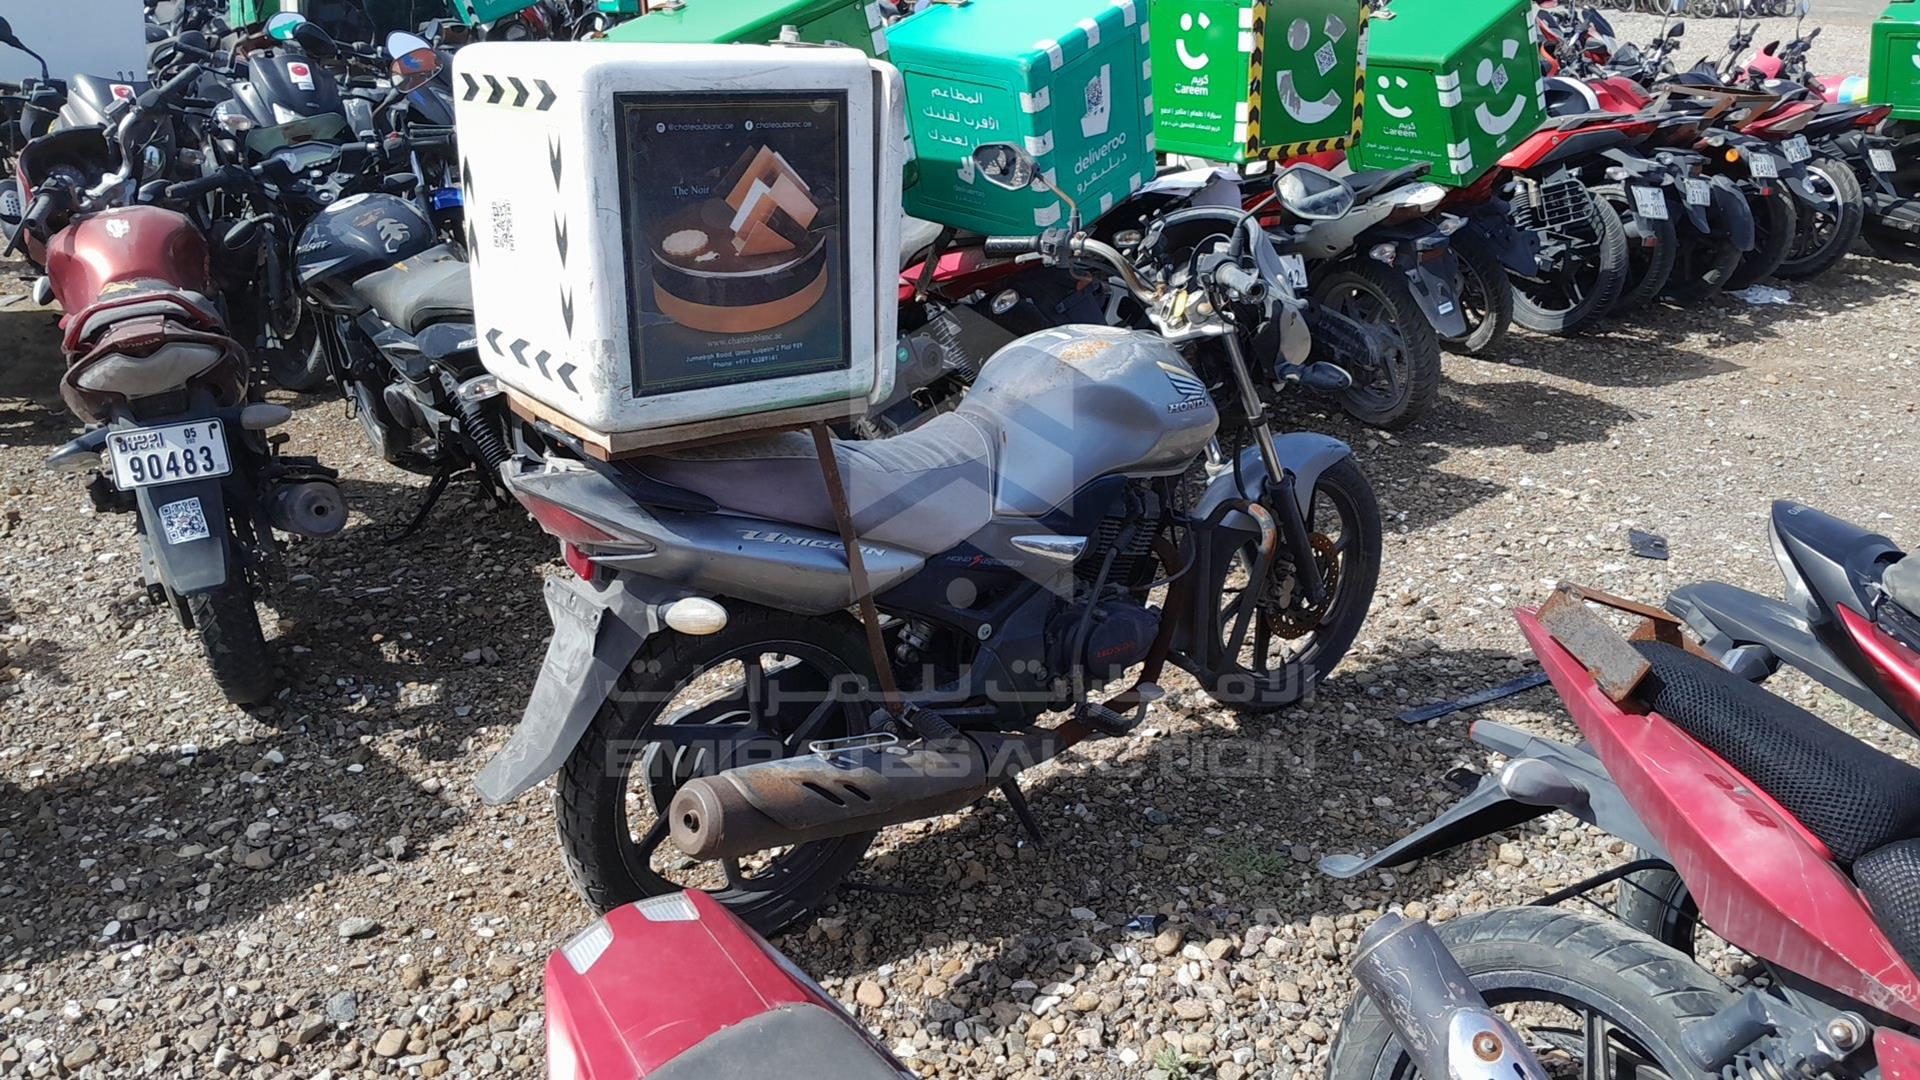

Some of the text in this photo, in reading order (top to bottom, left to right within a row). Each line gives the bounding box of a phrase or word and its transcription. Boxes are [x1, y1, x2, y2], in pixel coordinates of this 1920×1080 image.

[931, 87, 983, 104] المطاعم
[1074, 132, 1127, 174] deliveroo
[672, 184, 710, 196] The Noir
[183, 428, 197, 439] 05
[129, 445, 215, 482] 90483
